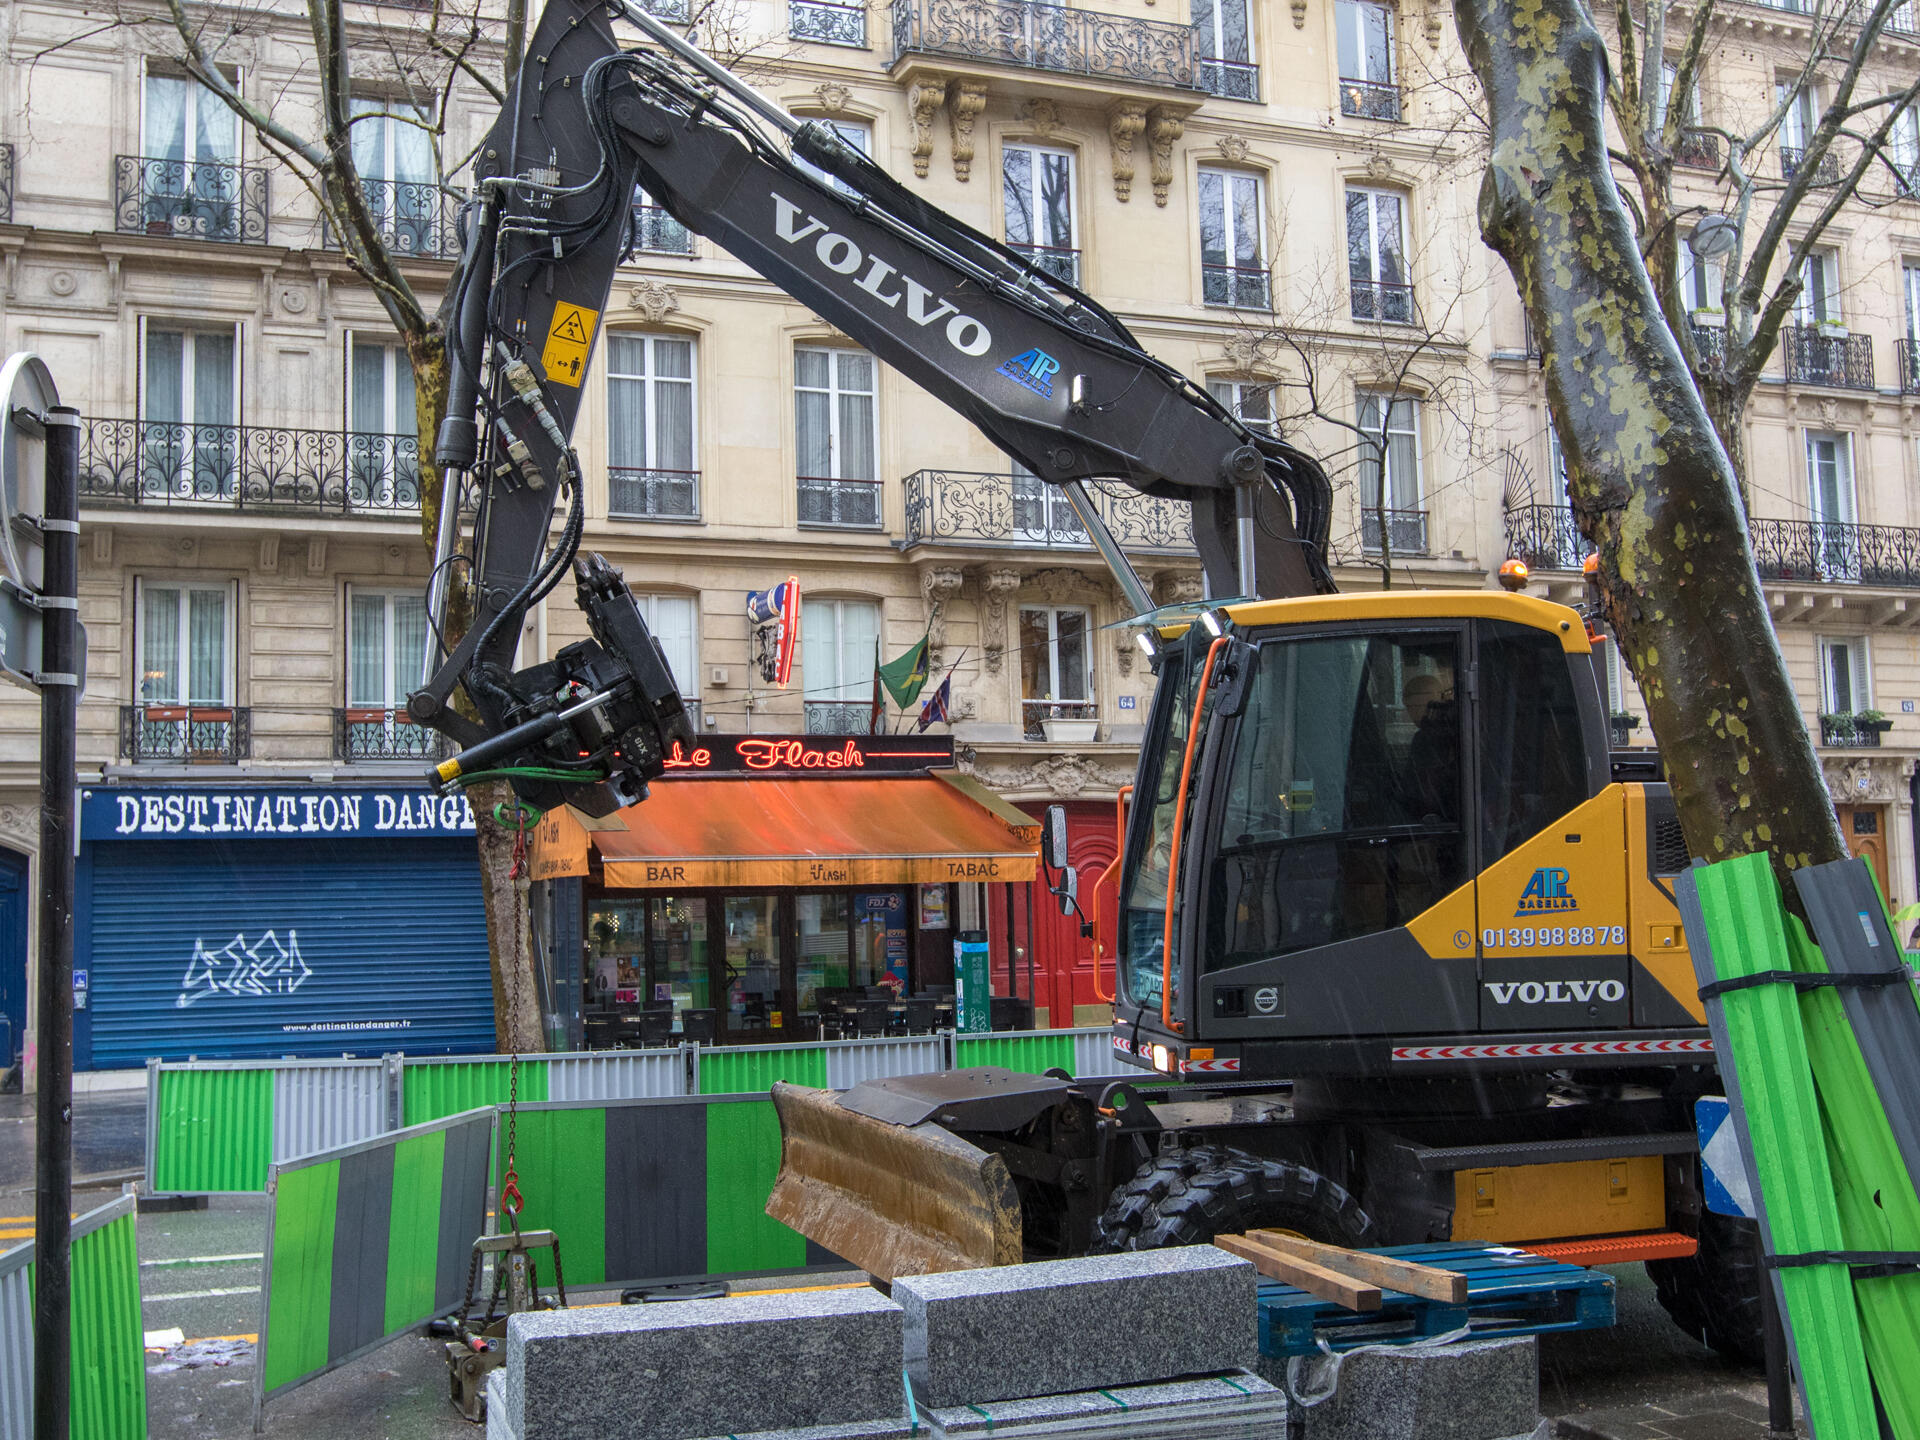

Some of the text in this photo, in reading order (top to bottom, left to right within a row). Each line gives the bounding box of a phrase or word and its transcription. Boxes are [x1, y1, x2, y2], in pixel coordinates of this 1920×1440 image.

[770, 191, 992, 357] VOLVO
[1003, 360, 1053, 397] CASELAS
[1120, 697, 1134, 708] 64
[736, 739, 864, 769] Flash
[115, 794, 477, 834] DESTINATION DANGE
[646, 866, 686, 882] BAR
[947, 863, 999, 877] TABAC
[868, 898, 885, 907] FDJ
[1517, 898, 1578, 909] CASELAS
[1484, 979, 1625, 1004] VOLVO
[283, 1020, 411, 1032] www.destinationdanger.fr
